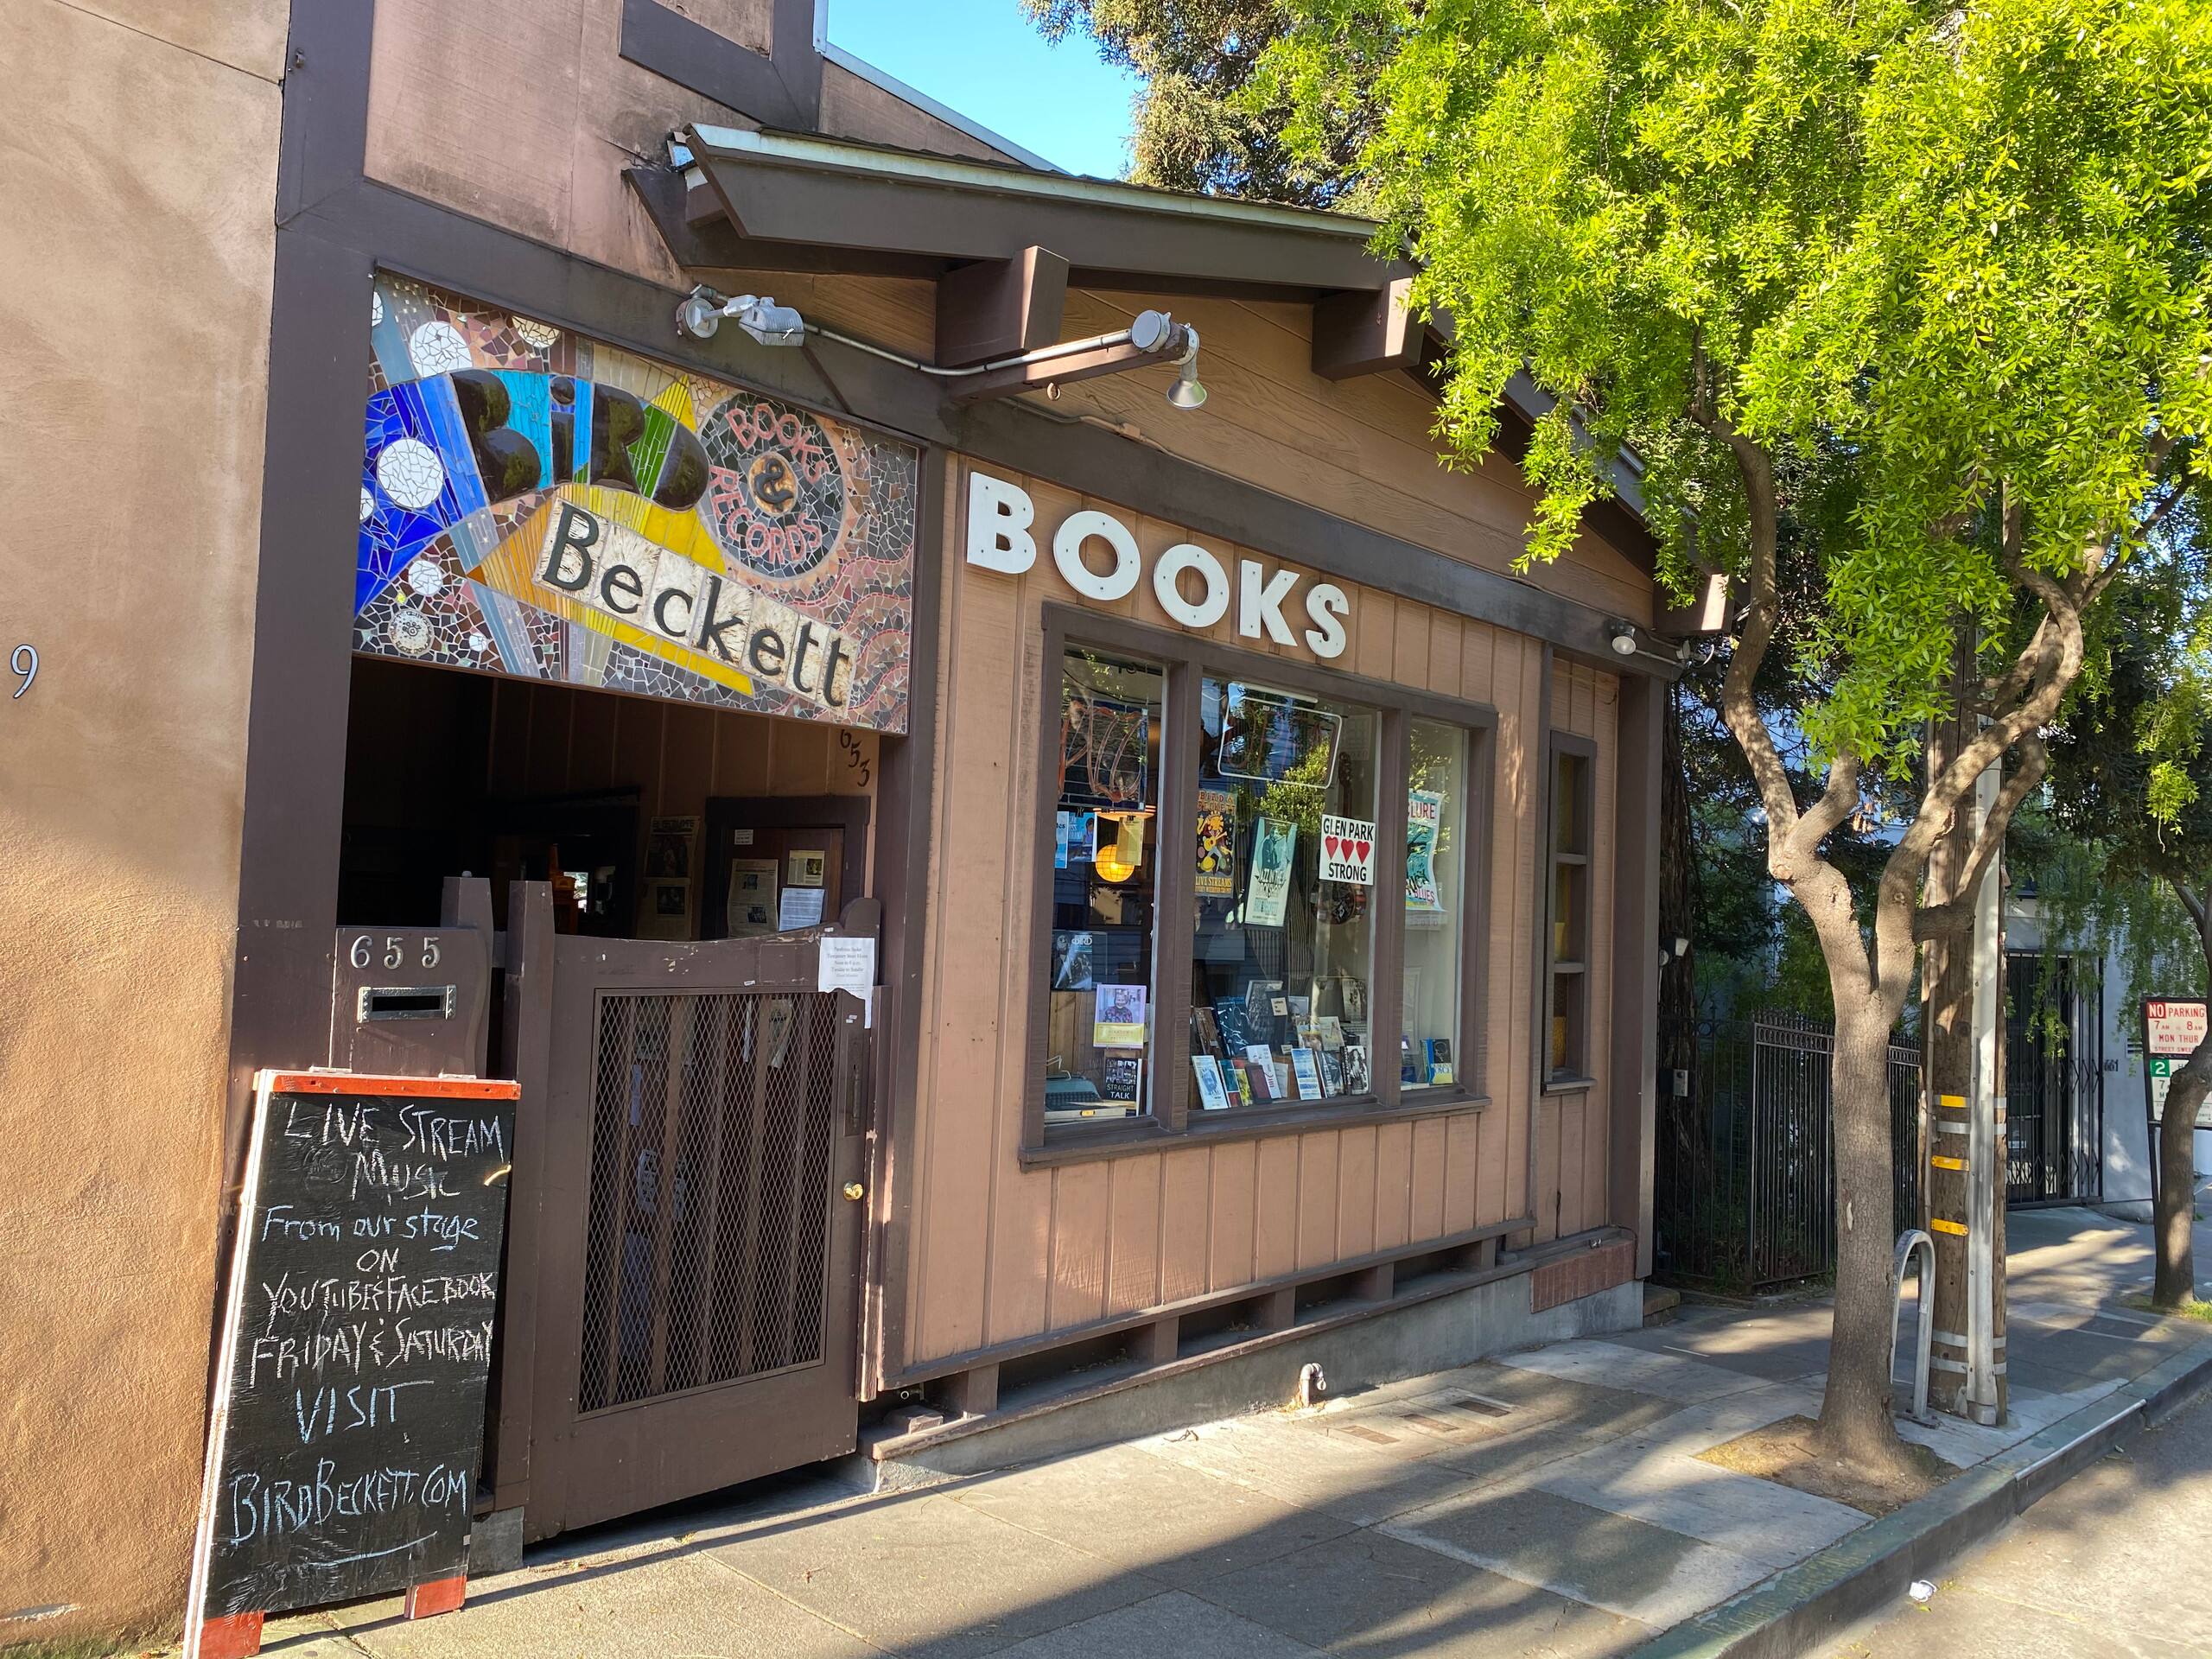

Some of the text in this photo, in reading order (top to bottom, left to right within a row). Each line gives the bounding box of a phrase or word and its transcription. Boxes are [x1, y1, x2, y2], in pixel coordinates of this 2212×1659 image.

[724, 403, 830, 484] BOOKS
[709, 465, 822, 565] RECORDS
[967, 471, 1350, 658] BOOKS
[543, 502, 849, 707] Beckett
[10, 644, 39, 699] 9
[1323, 817, 1374, 842] GLEN PARK
[1328, 862, 1367, 881] STRONG
[350, 934, 442, 969] 655
[2149, 1003, 2205, 1018] NO PARKING
[2155, 1061, 2166, 1075] 2
[1110, 1091, 1130, 1100] TALK
[284, 1101, 505, 1163] LIVE STREAM
[263, 1205, 480, 1251] From our stage
[356, 1248, 399, 1274] ON
[250, 1321, 367, 1389] FRIDAY
[385, 1317, 494, 1370] SATURDAY
[296, 1381, 434, 1444] VISIT
